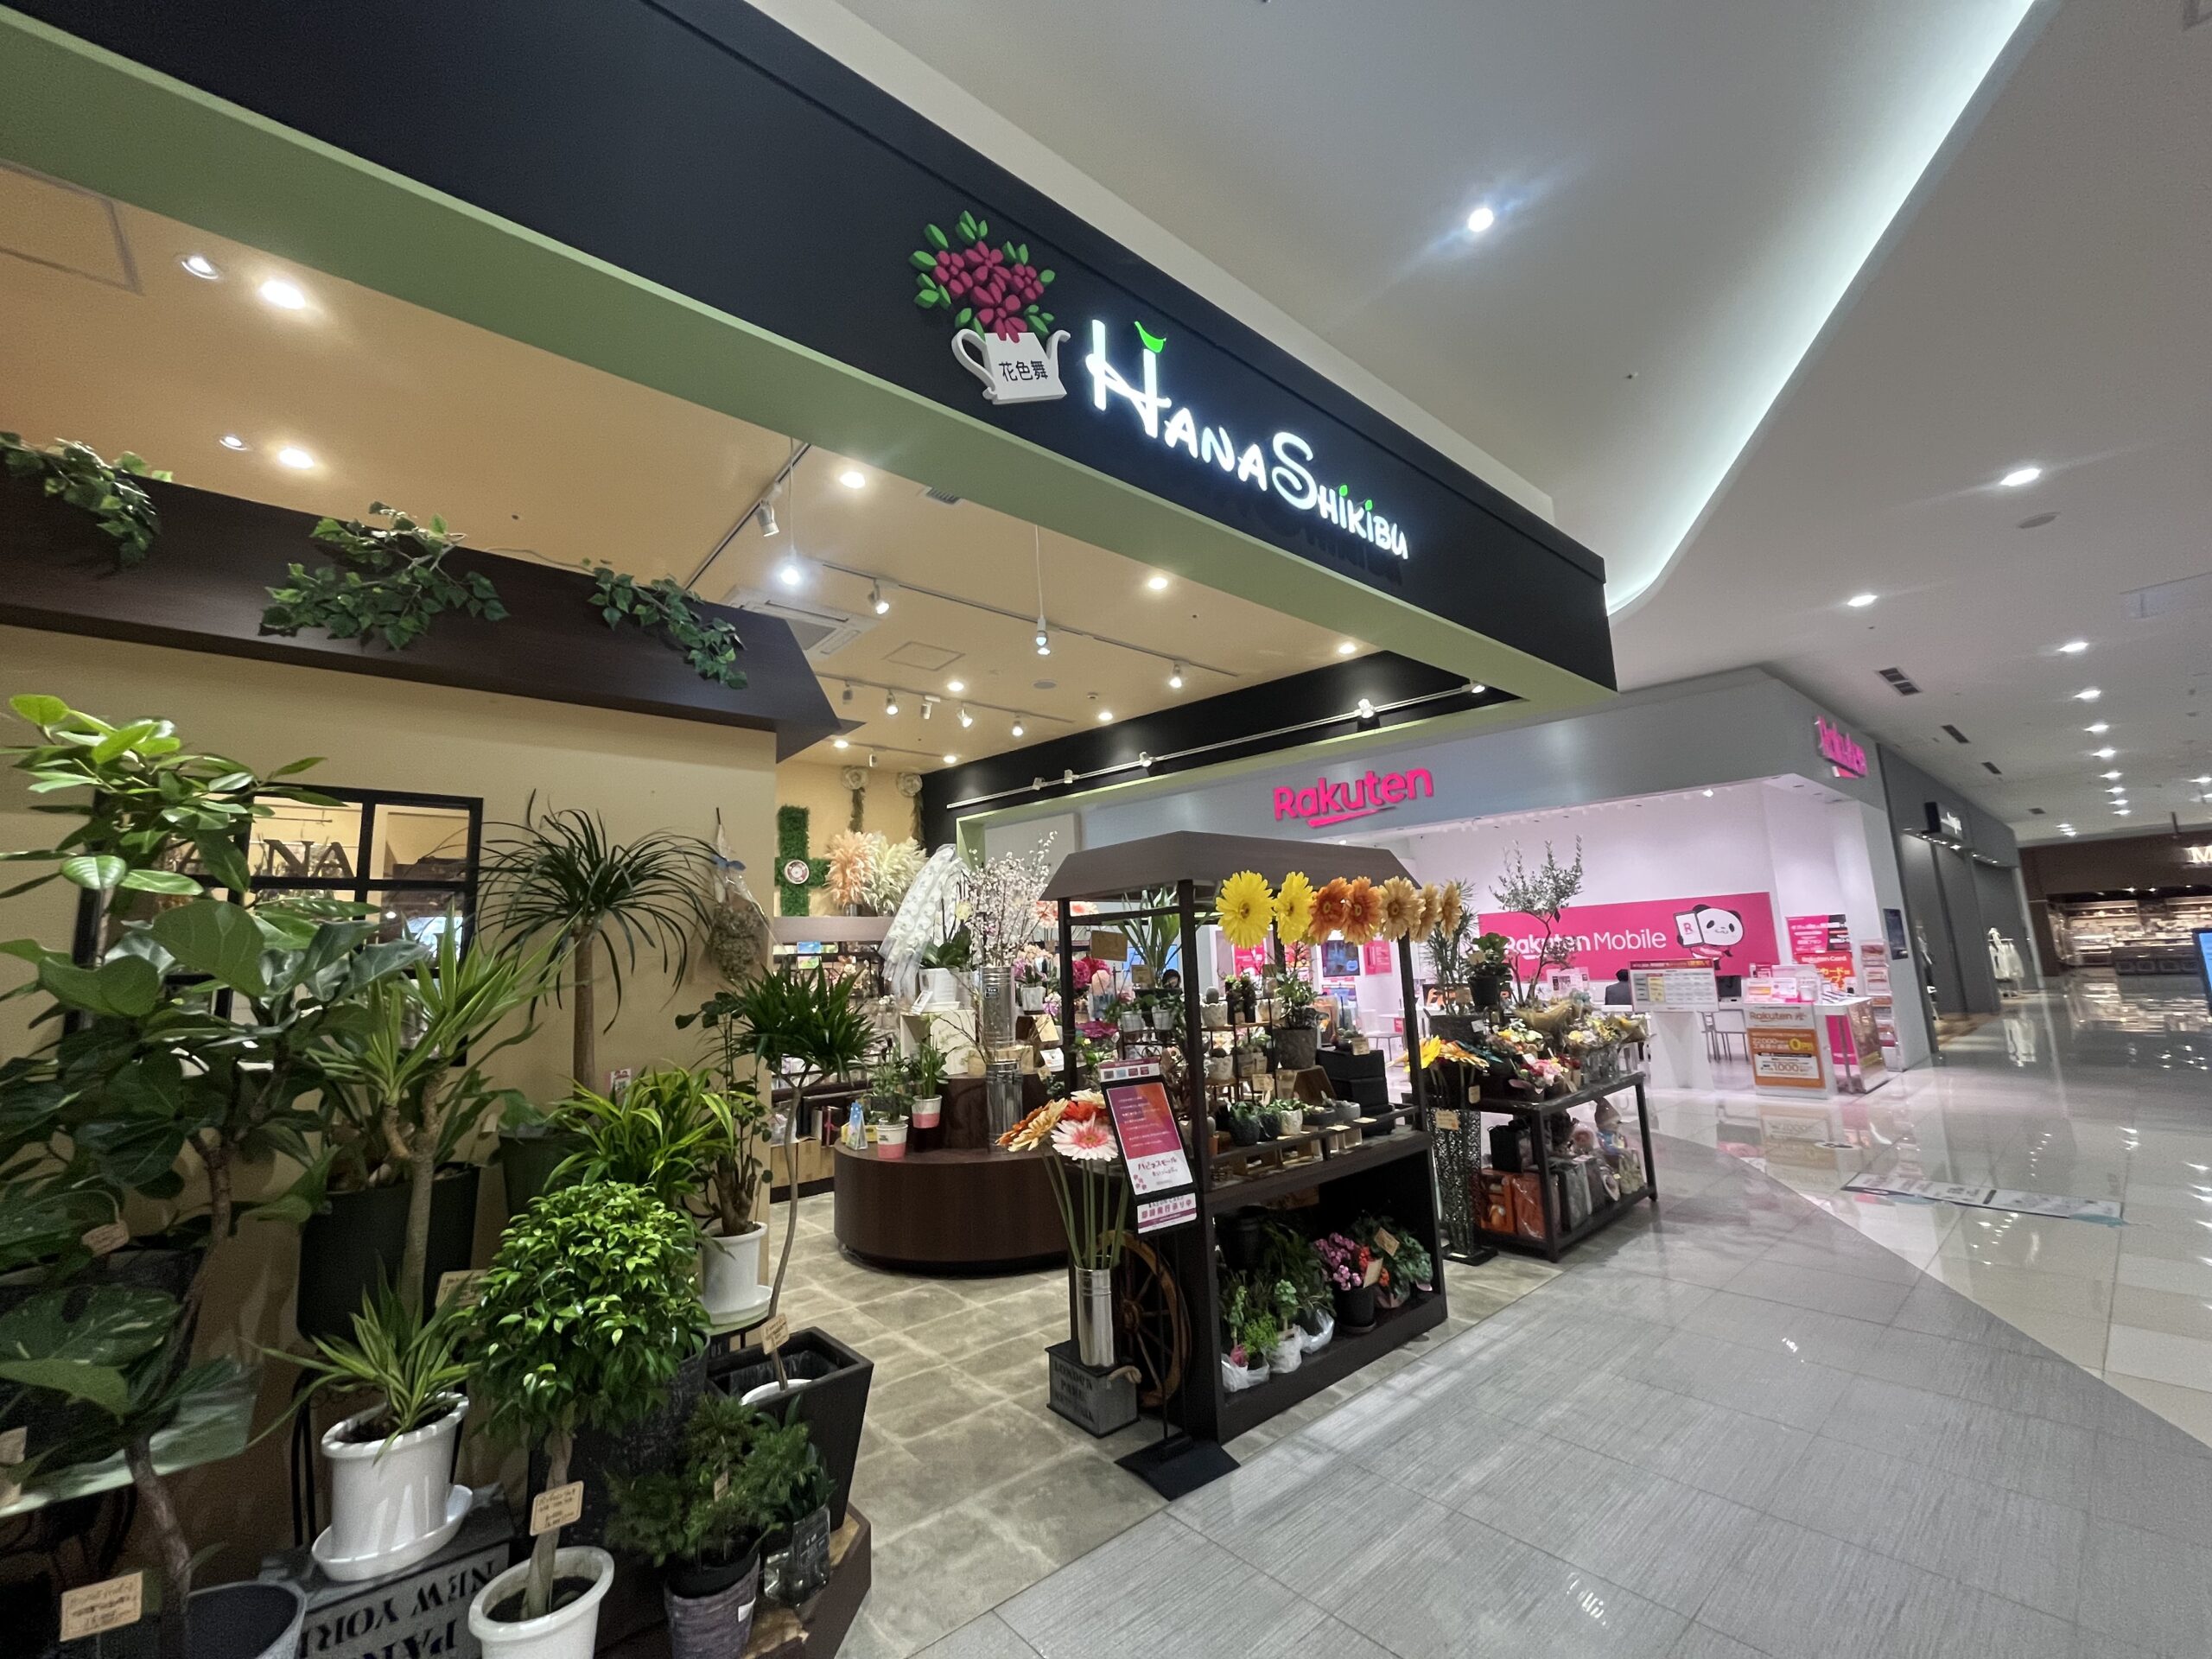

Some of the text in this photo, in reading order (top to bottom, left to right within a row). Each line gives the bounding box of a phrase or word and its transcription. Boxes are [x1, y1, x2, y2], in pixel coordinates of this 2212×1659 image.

[999, 359, 1049, 383] 花色舞
[1273, 766, 1433, 823] Rakuten
[1593, 928, 1667, 950] Mobile
[1750, 1011, 1792, 1021] Rakuten
